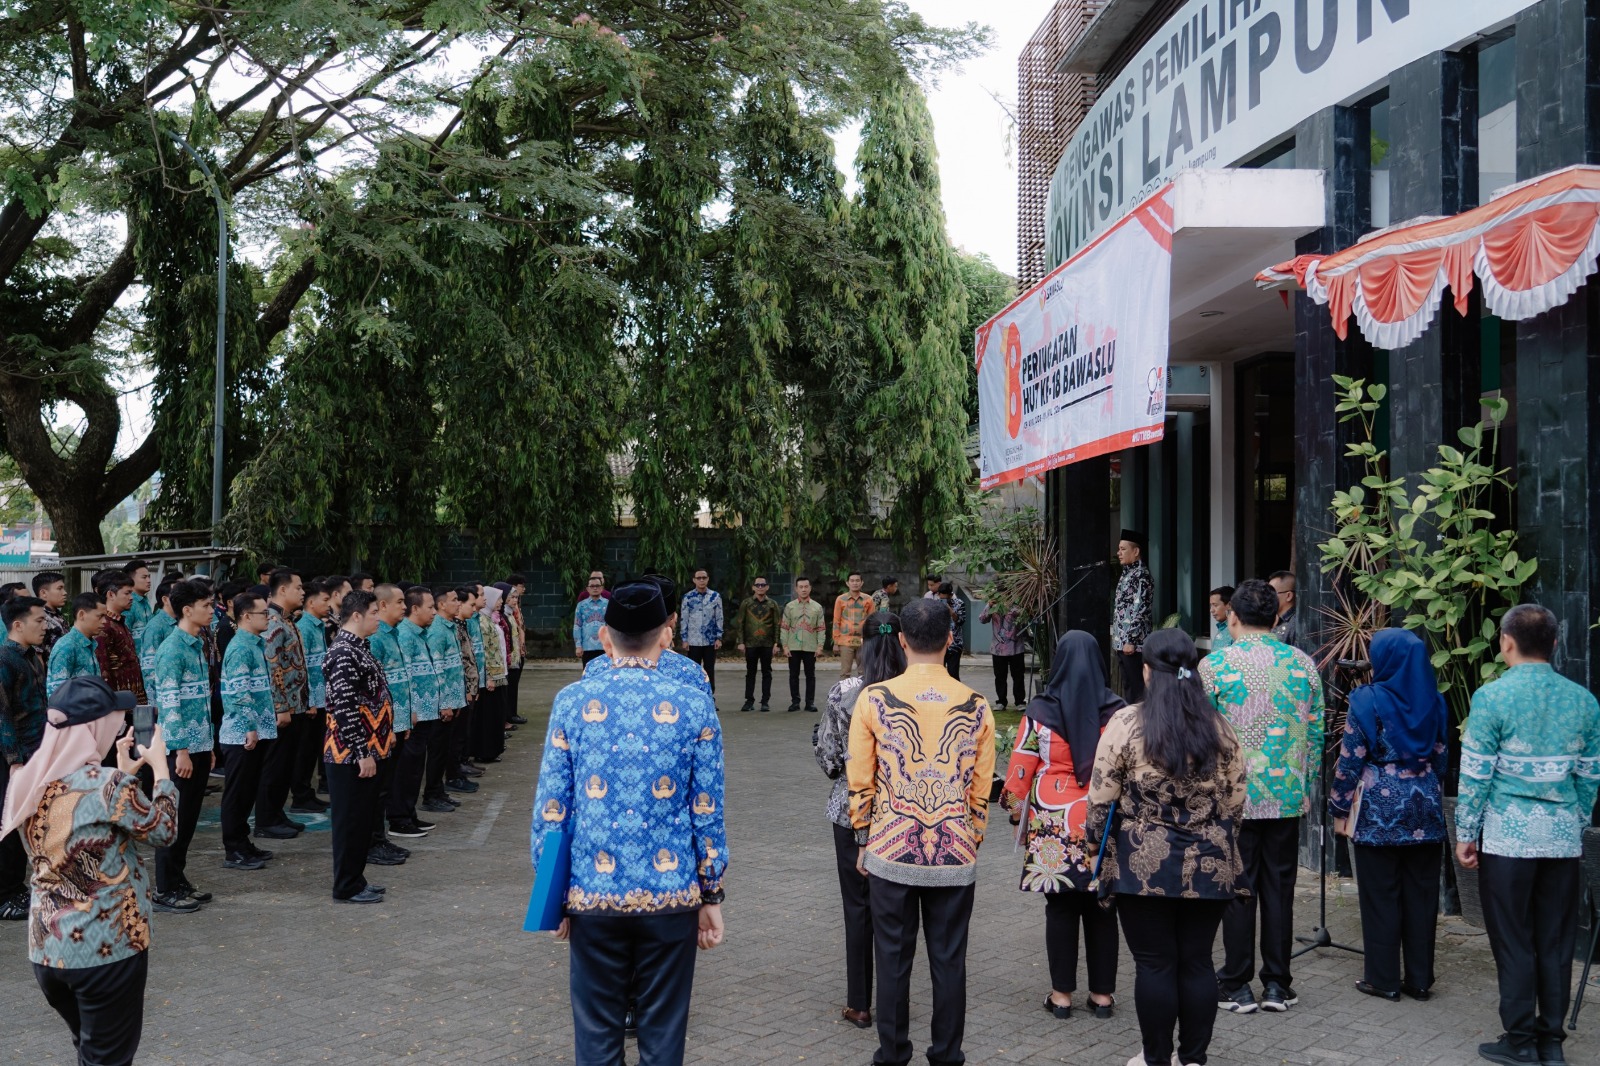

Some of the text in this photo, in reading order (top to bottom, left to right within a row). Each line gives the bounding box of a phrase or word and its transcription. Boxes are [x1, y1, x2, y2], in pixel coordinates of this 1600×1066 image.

[1064, 78, 1135, 200] PENGAWAS
[1022, 324, 1077, 385] PERINGATAN
[1022, 382, 1039, 415] HUT
[1063, 340, 1115, 395] BAWASLU
